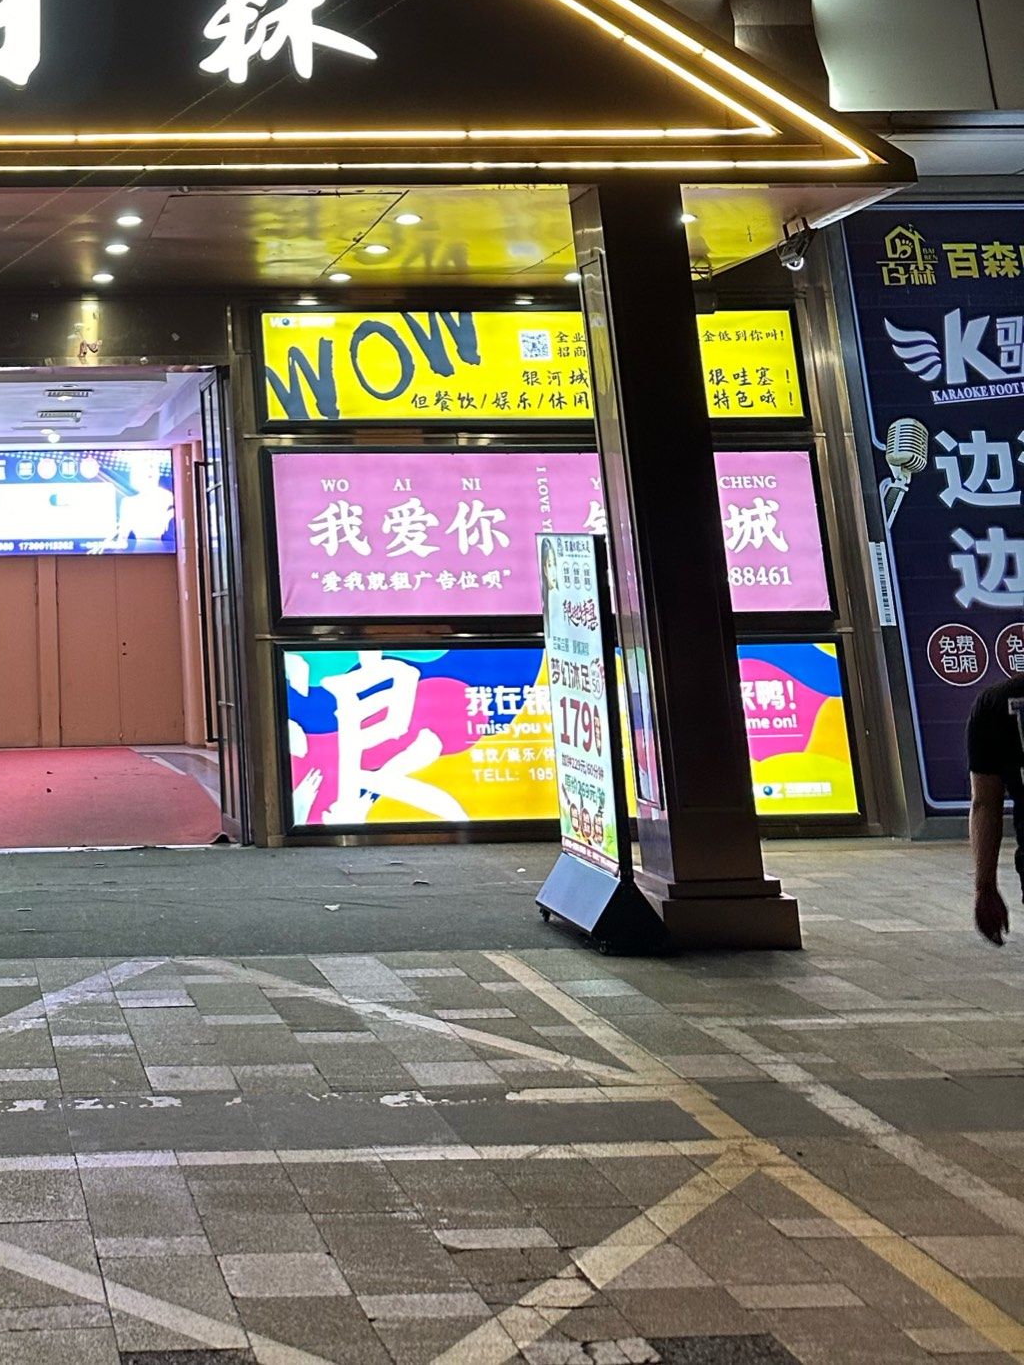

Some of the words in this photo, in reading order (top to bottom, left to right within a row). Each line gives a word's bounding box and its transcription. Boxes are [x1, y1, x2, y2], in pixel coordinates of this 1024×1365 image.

[941, 241, 1024, 279] 百森
[557, 346, 586, 358] 招商
[264, 312, 482, 419] WOW
[521, 368, 589, 388] 银河城
[931, 385, 988, 402] KARAOKE
[989, 383, 1020, 396] FOOT
[934, 430, 1024, 509] 边
[320, 479, 349, 493] WO
[393, 479, 413, 492] AI
[461, 478, 482, 492] NI
[719, 476, 777, 489] CHENG
[537, 478, 551, 513] LOVE
[307, 497, 511, 558] 我爱你
[724, 497, 789, 554] 城
[728, 566, 792, 586] 88461
[939, 635, 976, 654] 免费
[941, 654, 978, 673] 包厢
[550, 657, 592, 694] 梦幻沐足
[476, 720, 511, 735] miss
[512, 722, 542, 739] you
[772, 713, 798, 729] on!
[559, 696, 593, 753] 179
[472, 766, 521, 783] TELL:
